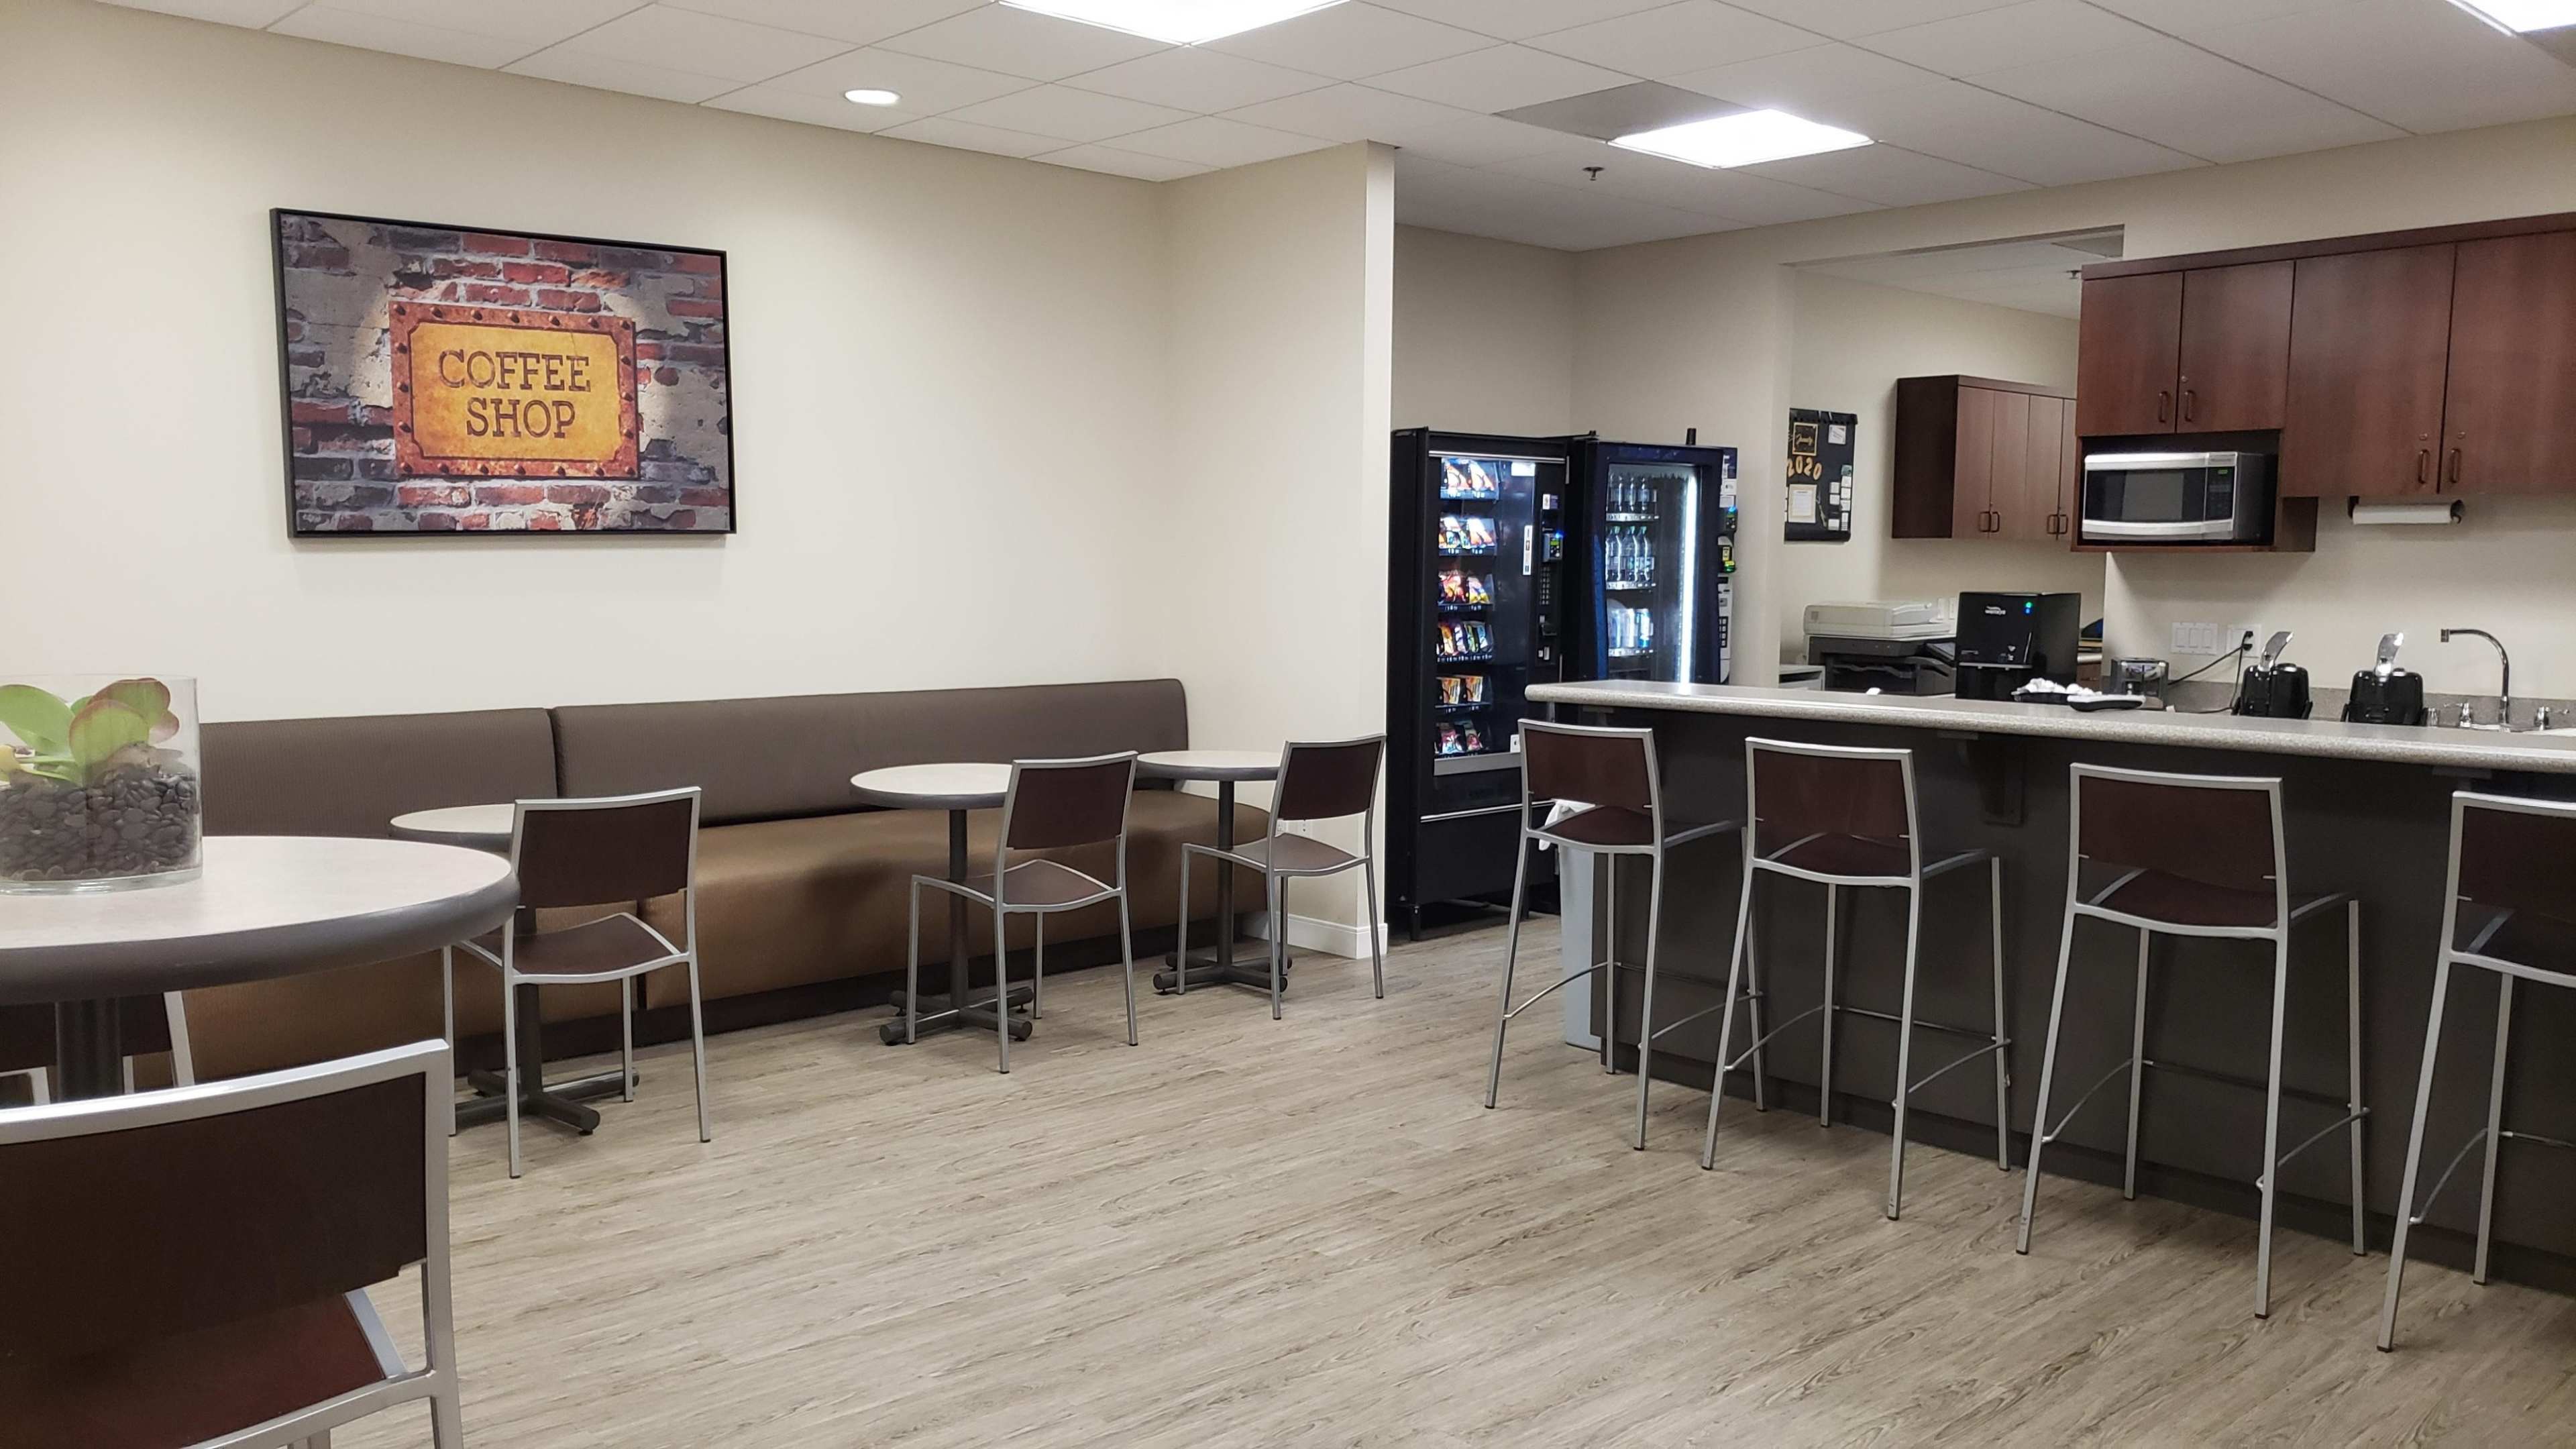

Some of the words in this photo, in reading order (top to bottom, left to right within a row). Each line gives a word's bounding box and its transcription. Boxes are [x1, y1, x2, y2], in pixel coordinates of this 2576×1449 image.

[438, 349, 591, 392] COFFEE
[466, 397, 576, 439] SHOP
[1787, 455, 1822, 480] 2020
